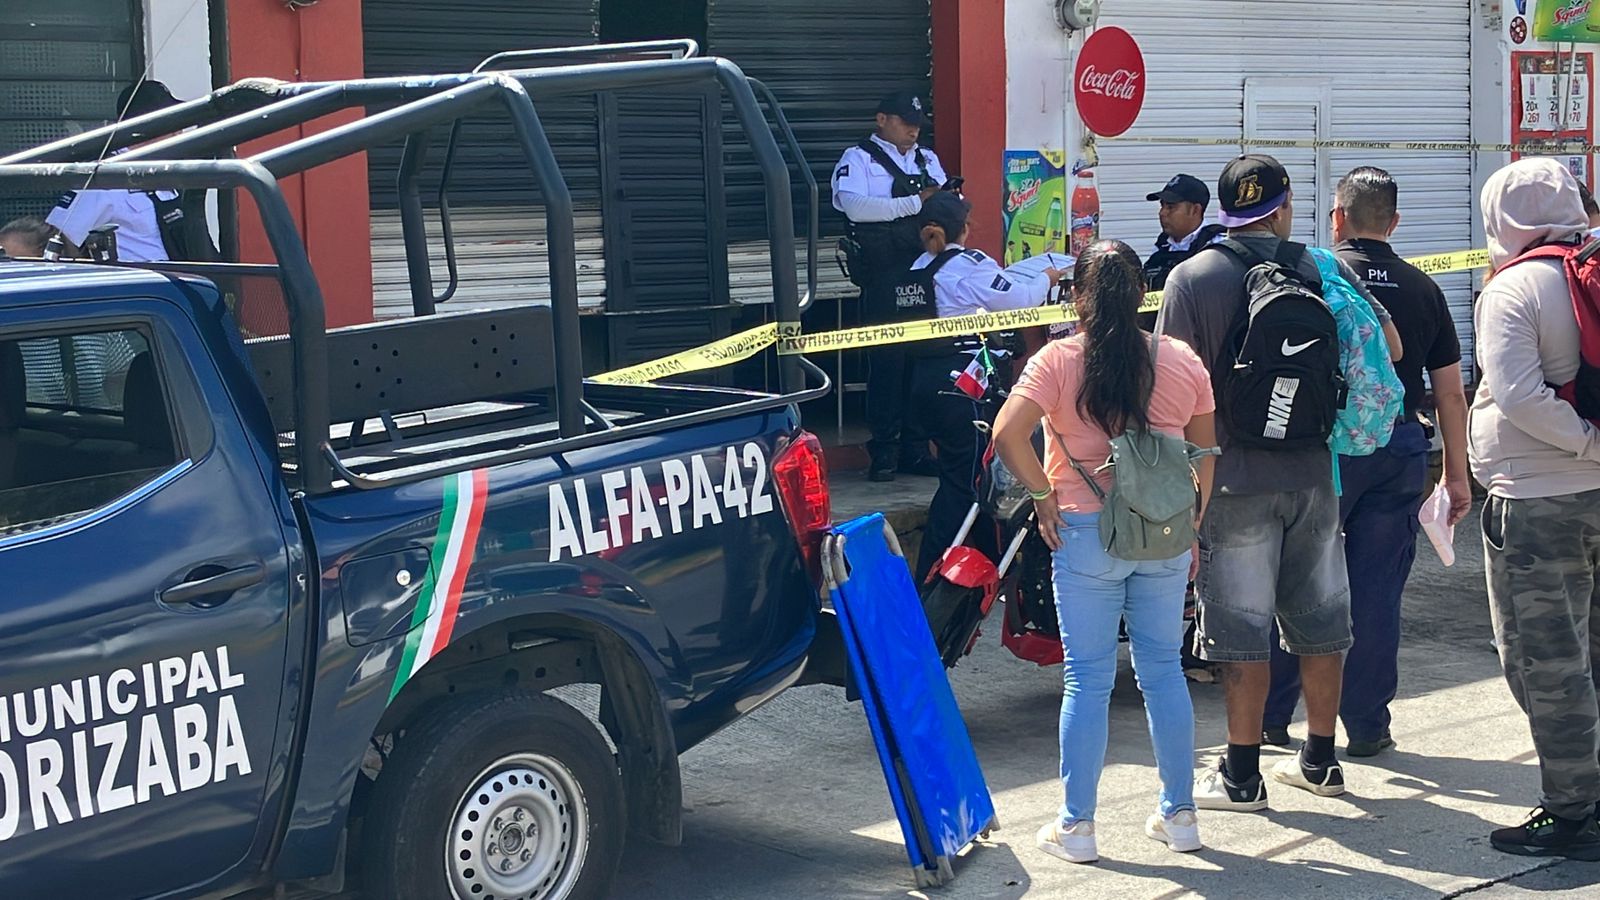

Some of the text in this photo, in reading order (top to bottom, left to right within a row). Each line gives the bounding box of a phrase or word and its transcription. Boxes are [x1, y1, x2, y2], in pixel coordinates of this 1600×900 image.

[1079, 64, 1140, 100] Coca-Cola
[1368, 269, 1388, 281] PM
[929, 313, 994, 334] PROHIBIDO
[1263, 376, 1300, 440] NIKE
[548, 442, 774, 563] ALFA-PA-42
